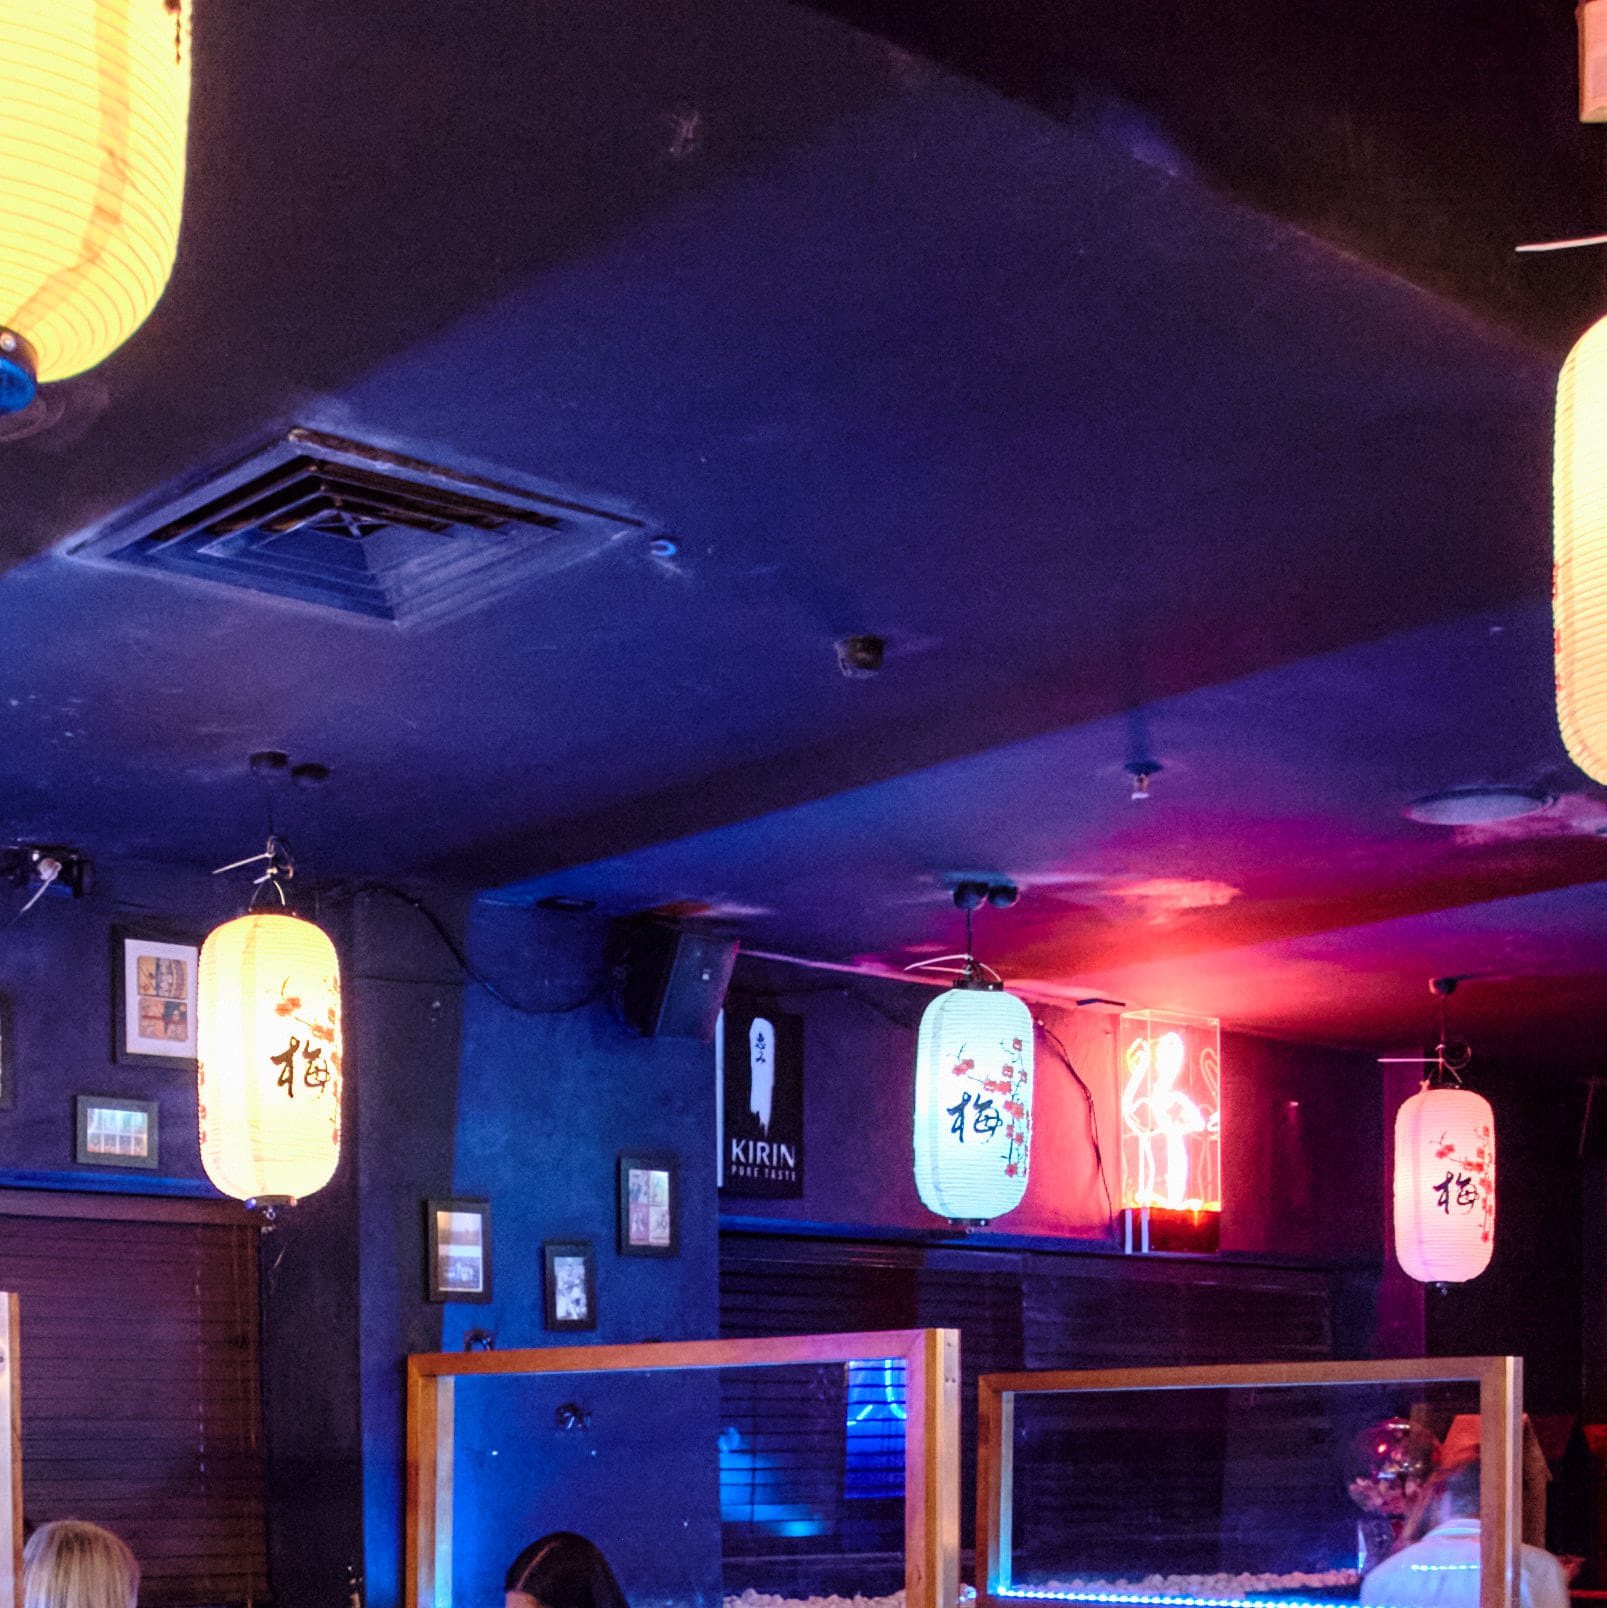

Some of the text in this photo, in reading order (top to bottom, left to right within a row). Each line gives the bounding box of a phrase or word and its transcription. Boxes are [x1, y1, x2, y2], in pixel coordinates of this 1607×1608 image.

[732, 1138, 796, 1168] KIRIN
[731, 1165, 796, 1182] PURE TASTE
